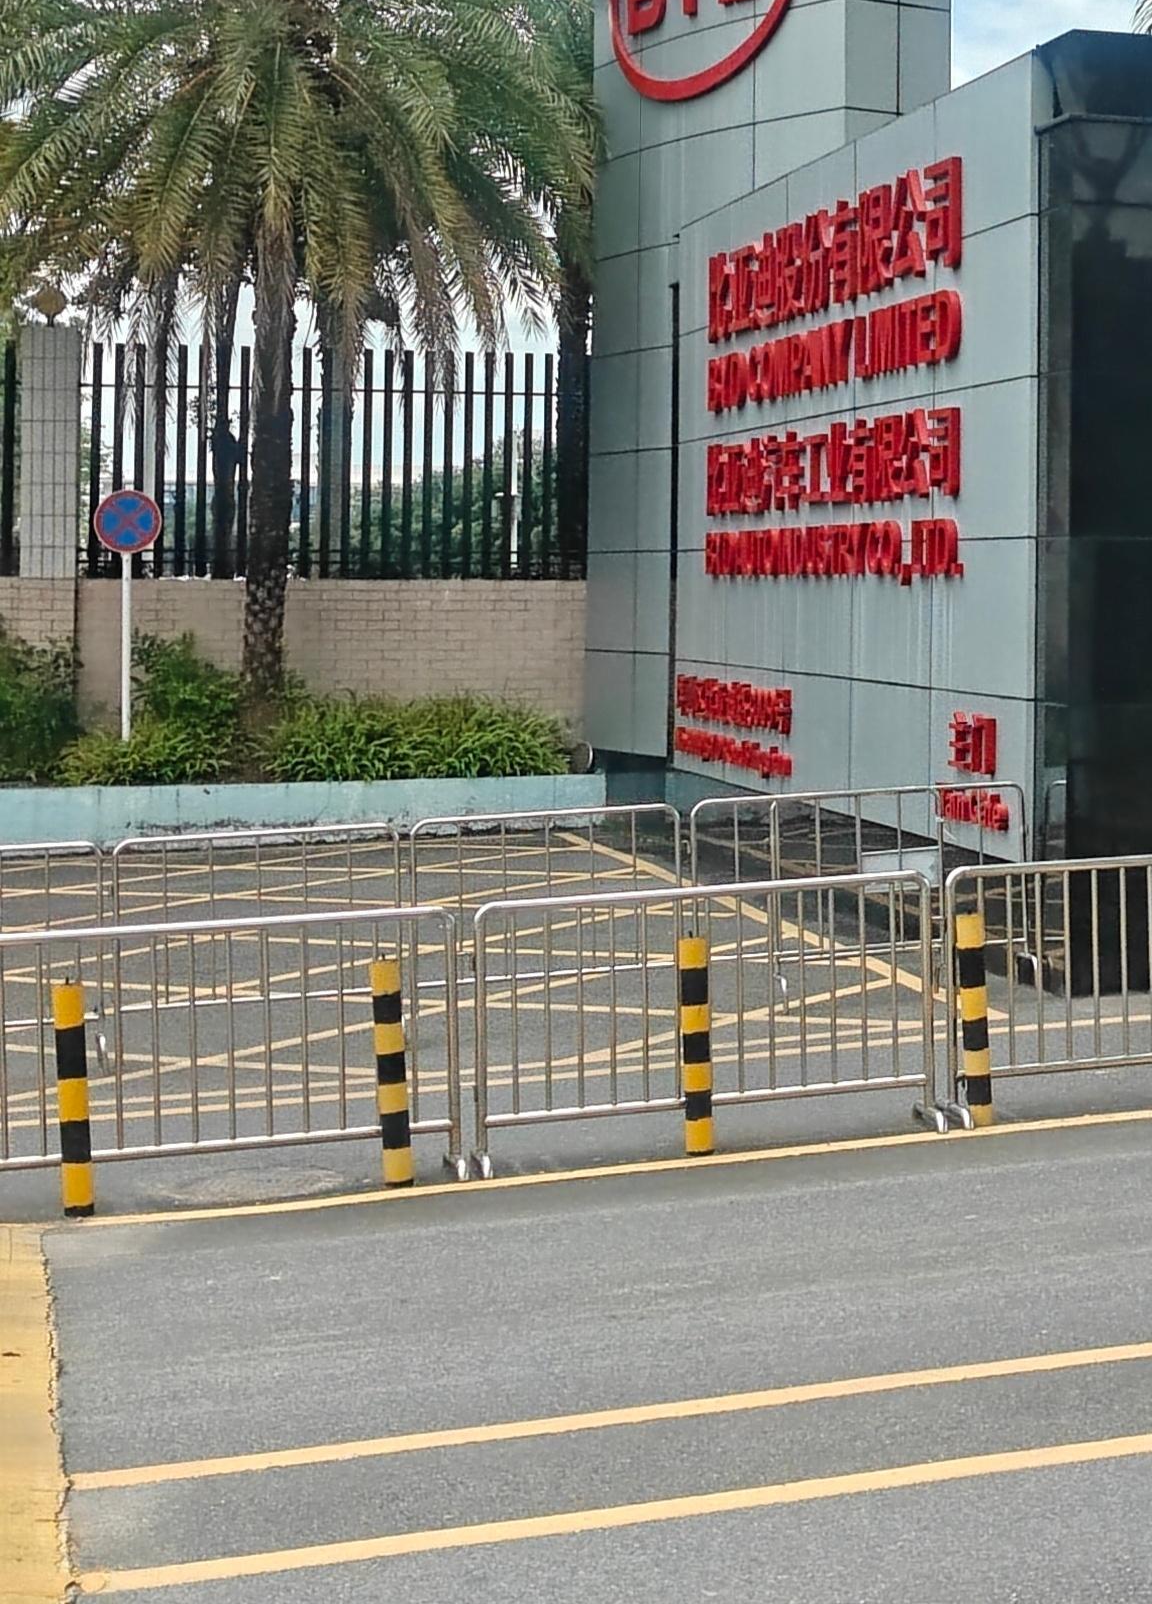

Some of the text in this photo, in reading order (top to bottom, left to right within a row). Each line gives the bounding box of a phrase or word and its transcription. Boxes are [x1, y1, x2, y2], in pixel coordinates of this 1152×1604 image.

[708, 156, 963, 344] 比亚迪股份有限公司
[749, 319, 849, 404] COMPANY
[854, 289, 962, 379] LIMITED
[706, 407, 962, 516] 比亚迪汽车工业有限公司
